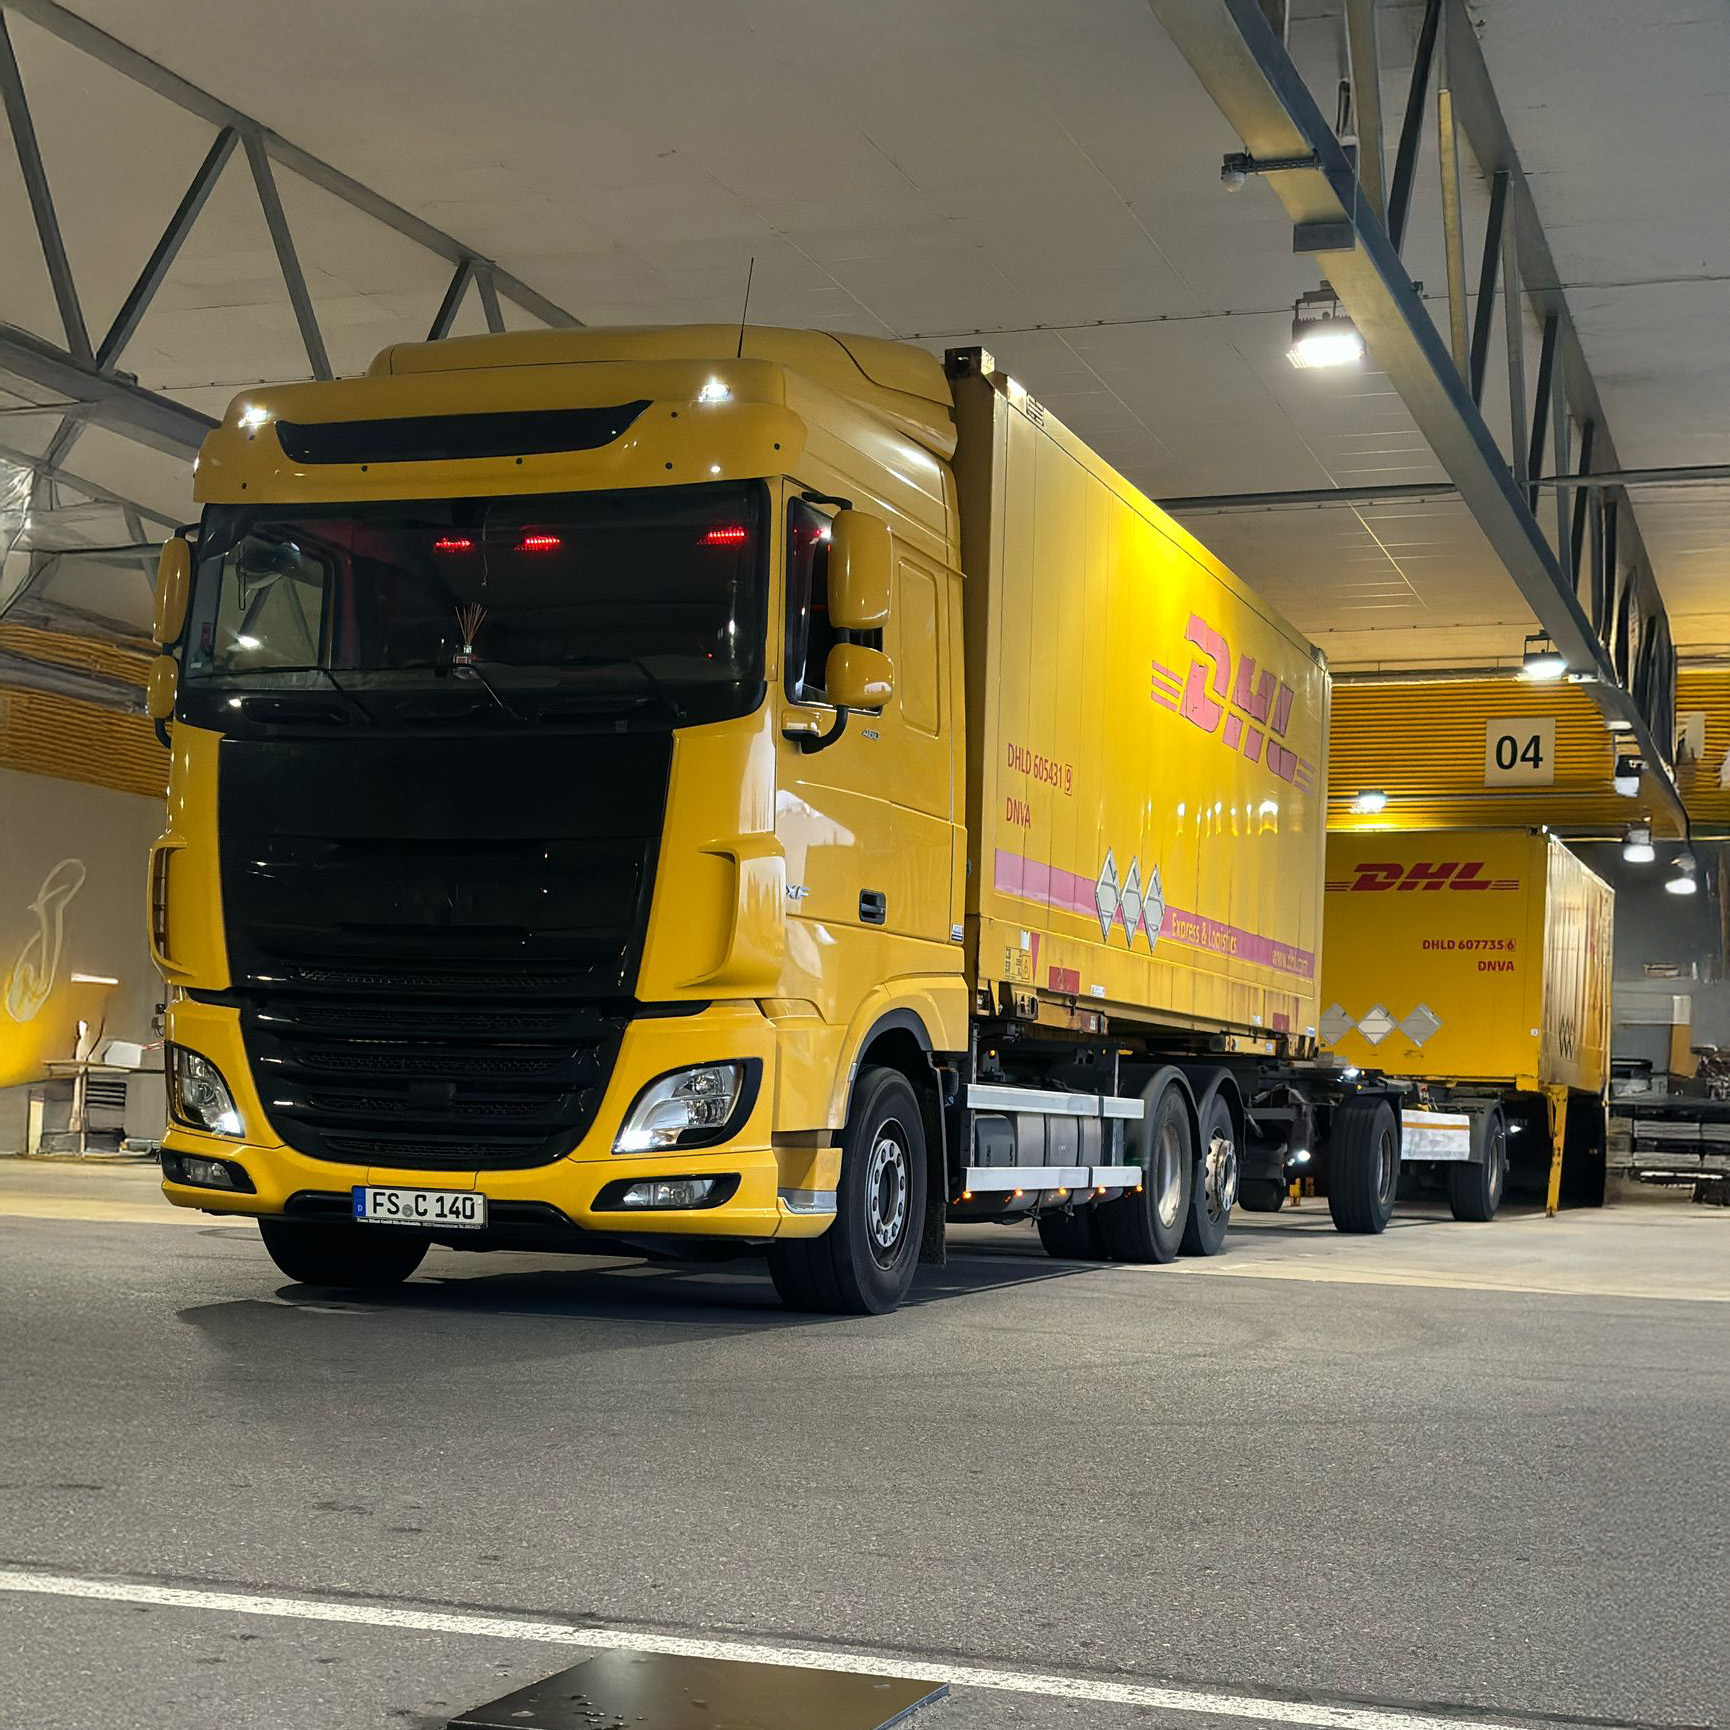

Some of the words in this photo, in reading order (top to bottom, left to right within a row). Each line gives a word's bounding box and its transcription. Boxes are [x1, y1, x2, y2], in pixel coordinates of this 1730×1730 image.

[1179, 612, 1298, 784] DHL
[1008, 743, 1031, 774] DHLD
[1496, 735, 1543, 770] 04
[1006, 797, 1031, 829] DNVA
[1350, 862, 1493, 891] DHL
[1172, 912, 1200, 943] Express
[1201, 921, 1207, 945] &
[1208, 923, 1237, 953] Logistics
[1422, 940, 1455, 950] DHLD
[1478, 960, 1514, 971] DNVA
[357, 1204, 363, 1212] D
[373, 1192, 400, 1215] FS
[415, 1194, 428, 1217] C
[435, 1196, 475, 1219] 140
